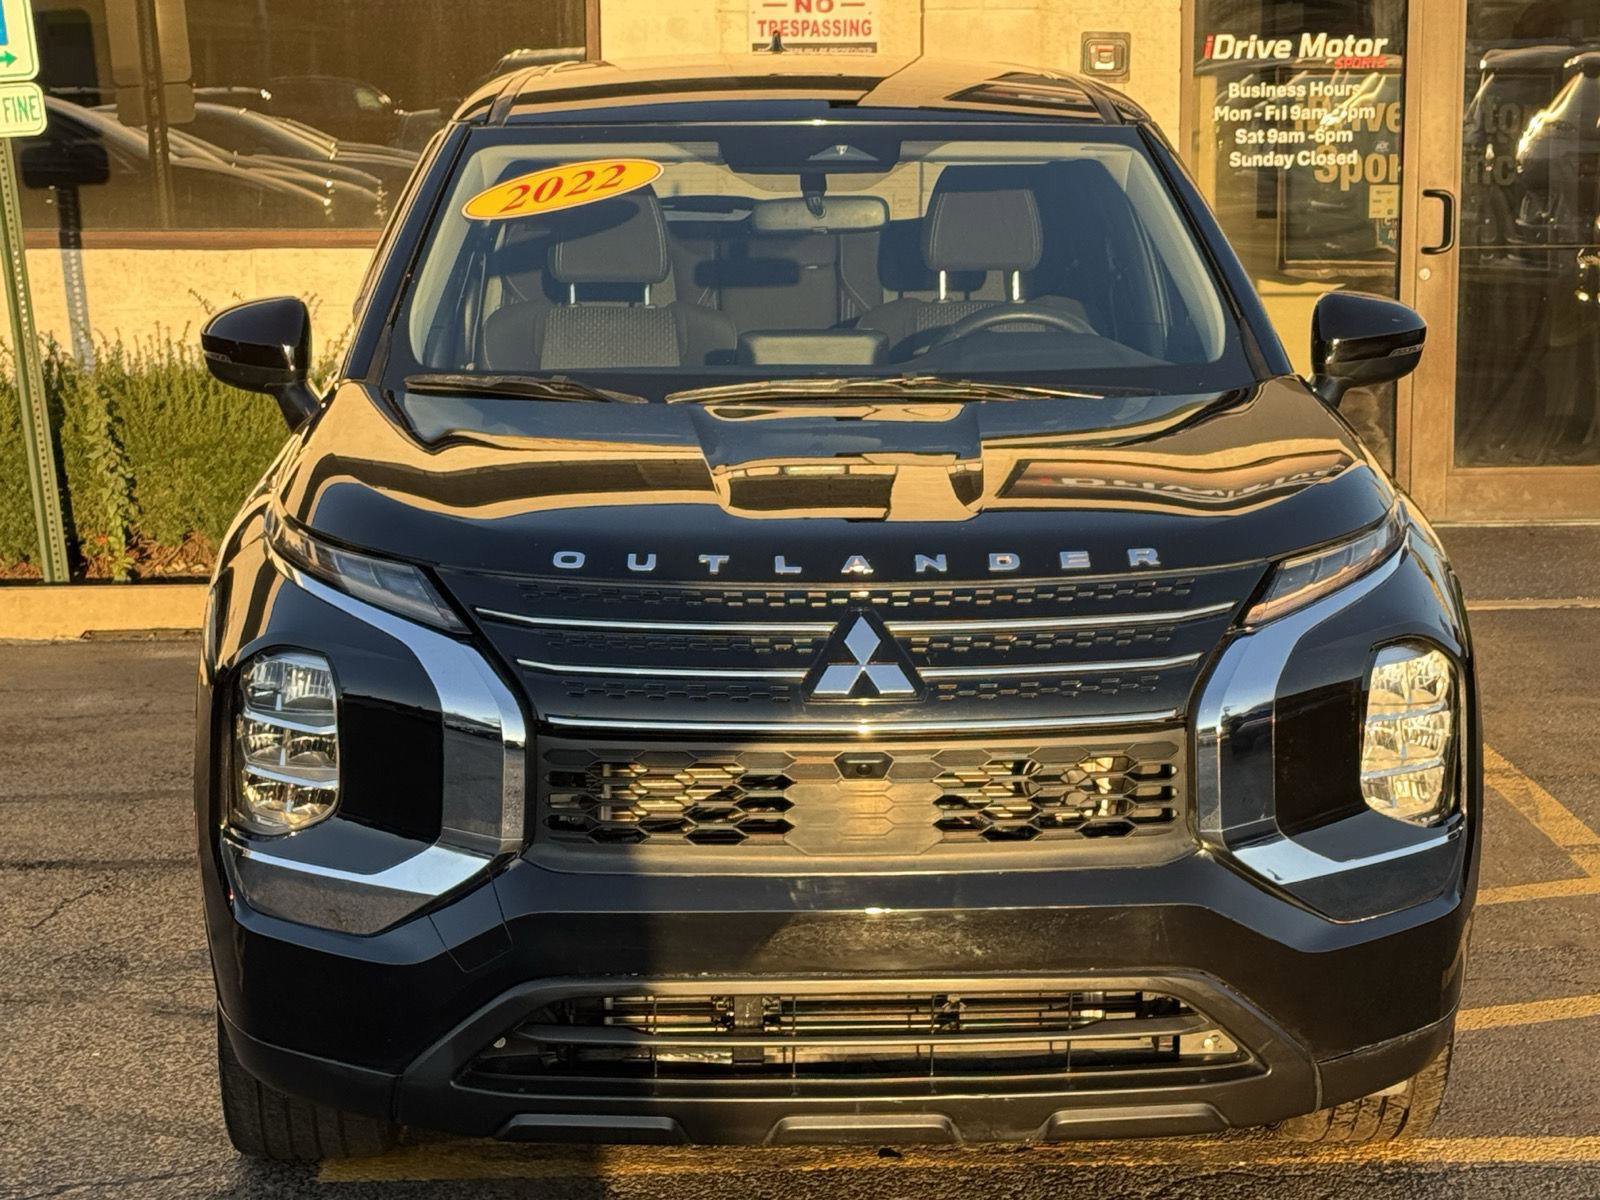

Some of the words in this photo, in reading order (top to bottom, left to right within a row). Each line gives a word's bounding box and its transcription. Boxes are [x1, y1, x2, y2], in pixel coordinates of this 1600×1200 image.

[794, 0, 834, 13] NO
[757, 19, 872, 37] TRESPASSING
[1203, 34, 1293, 60] iDrive
[1298, 32, 1389, 58] Motor
[1334, 56, 1388, 70] SPORTS
[1228, 82, 1306, 99] Business
[1309, 81, 1362, 97] Hours
[2, 95, 40, 123] FINE
[1214, 105, 1252, 122] Mon
[1265, 105, 1288, 122] Fri
[1290, 105, 1328, 121] 9am
[1235, 128, 1267, 145] Sat
[1267, 128, 1306, 144] 9am
[1229, 150, 1294, 169] Sunday
[1297, 149, 1359, 168] Closed
[498, 164, 626, 214] 2022
[552, 548, 1162, 576] OUTLANDER
